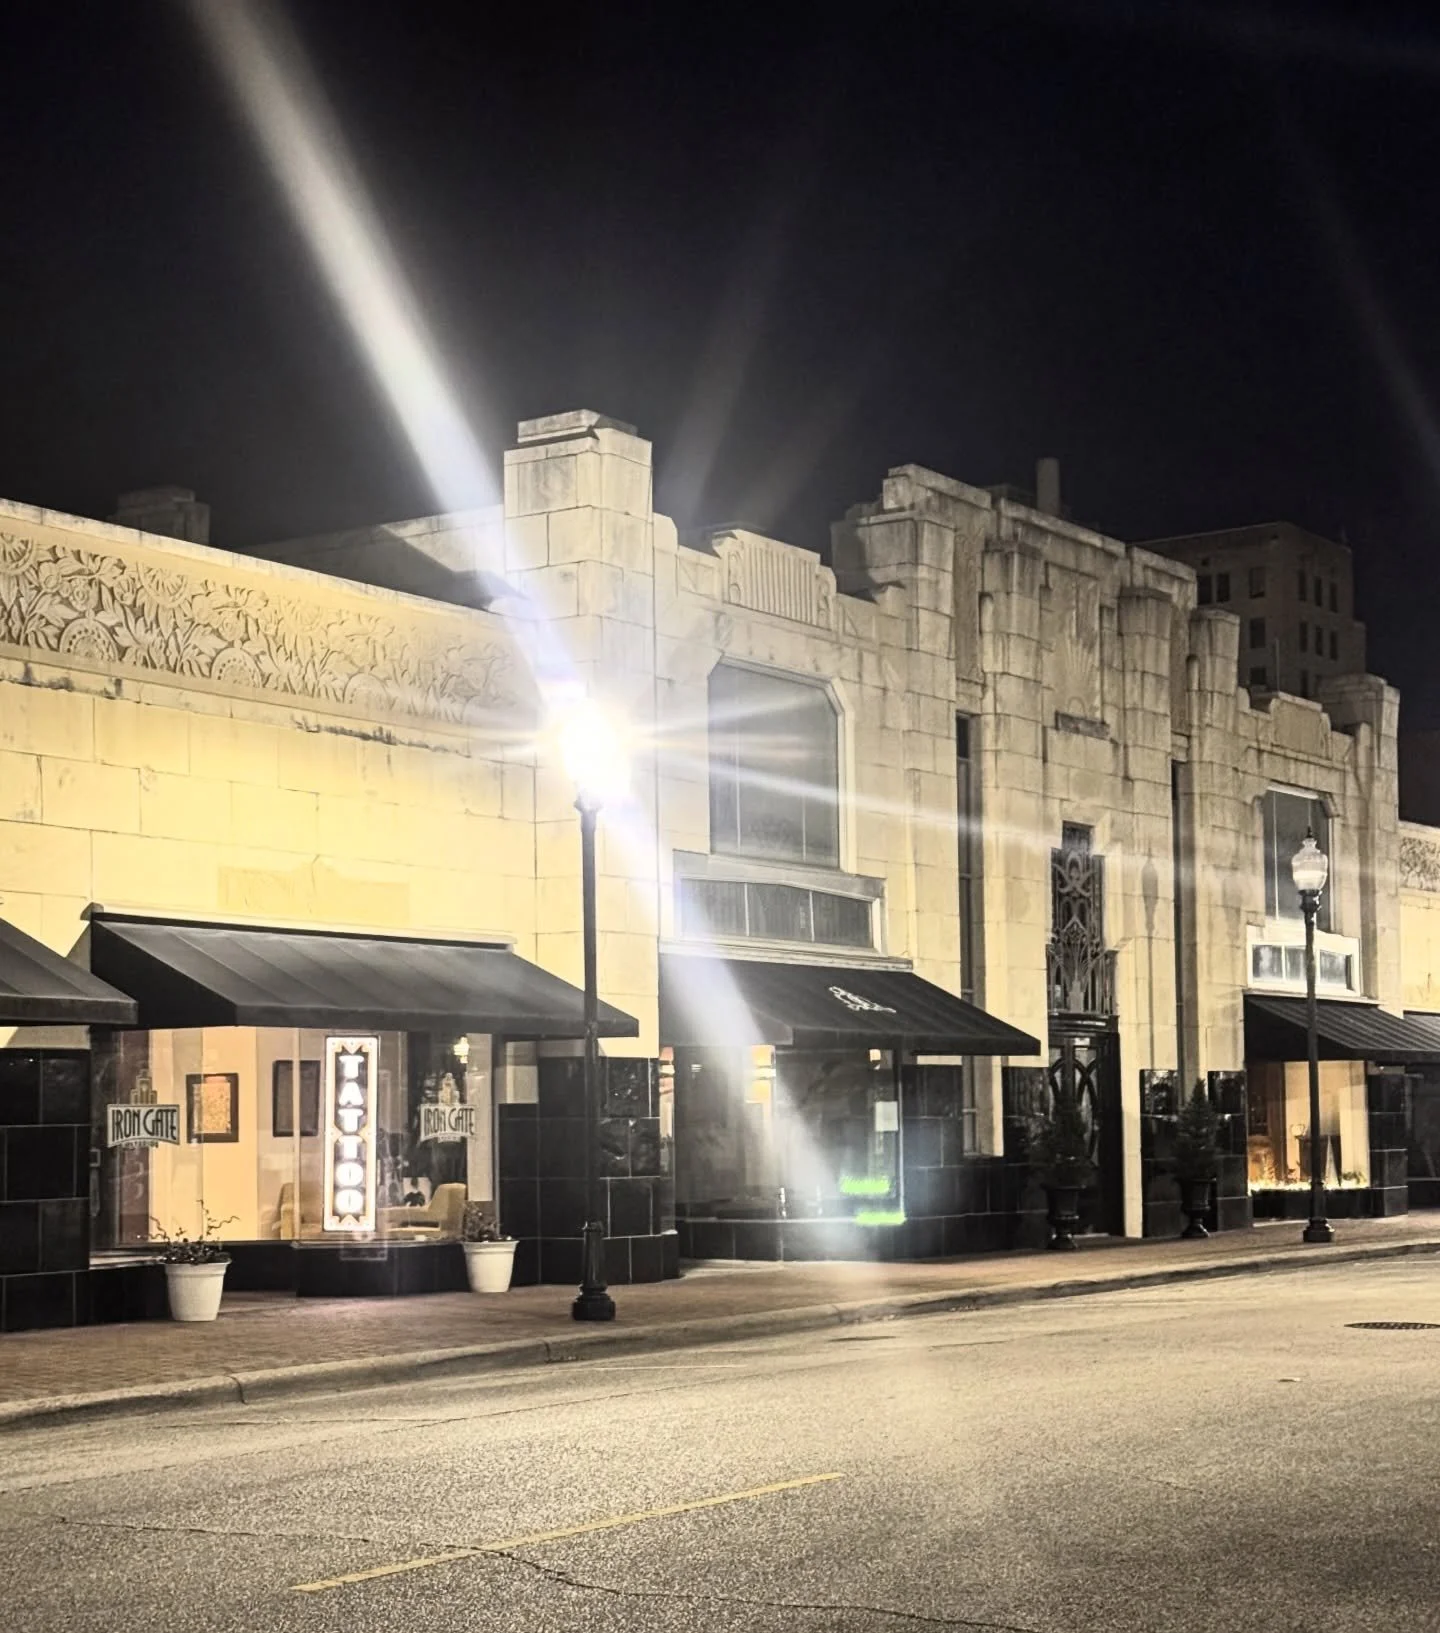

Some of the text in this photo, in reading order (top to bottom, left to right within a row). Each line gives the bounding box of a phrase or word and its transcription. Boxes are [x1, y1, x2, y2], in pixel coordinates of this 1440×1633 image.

[111, 1108, 177, 1142] IRON GATE
[334, 1054, 365, 1215] TATTOO
[424, 1107, 475, 1137] IRON GATE
